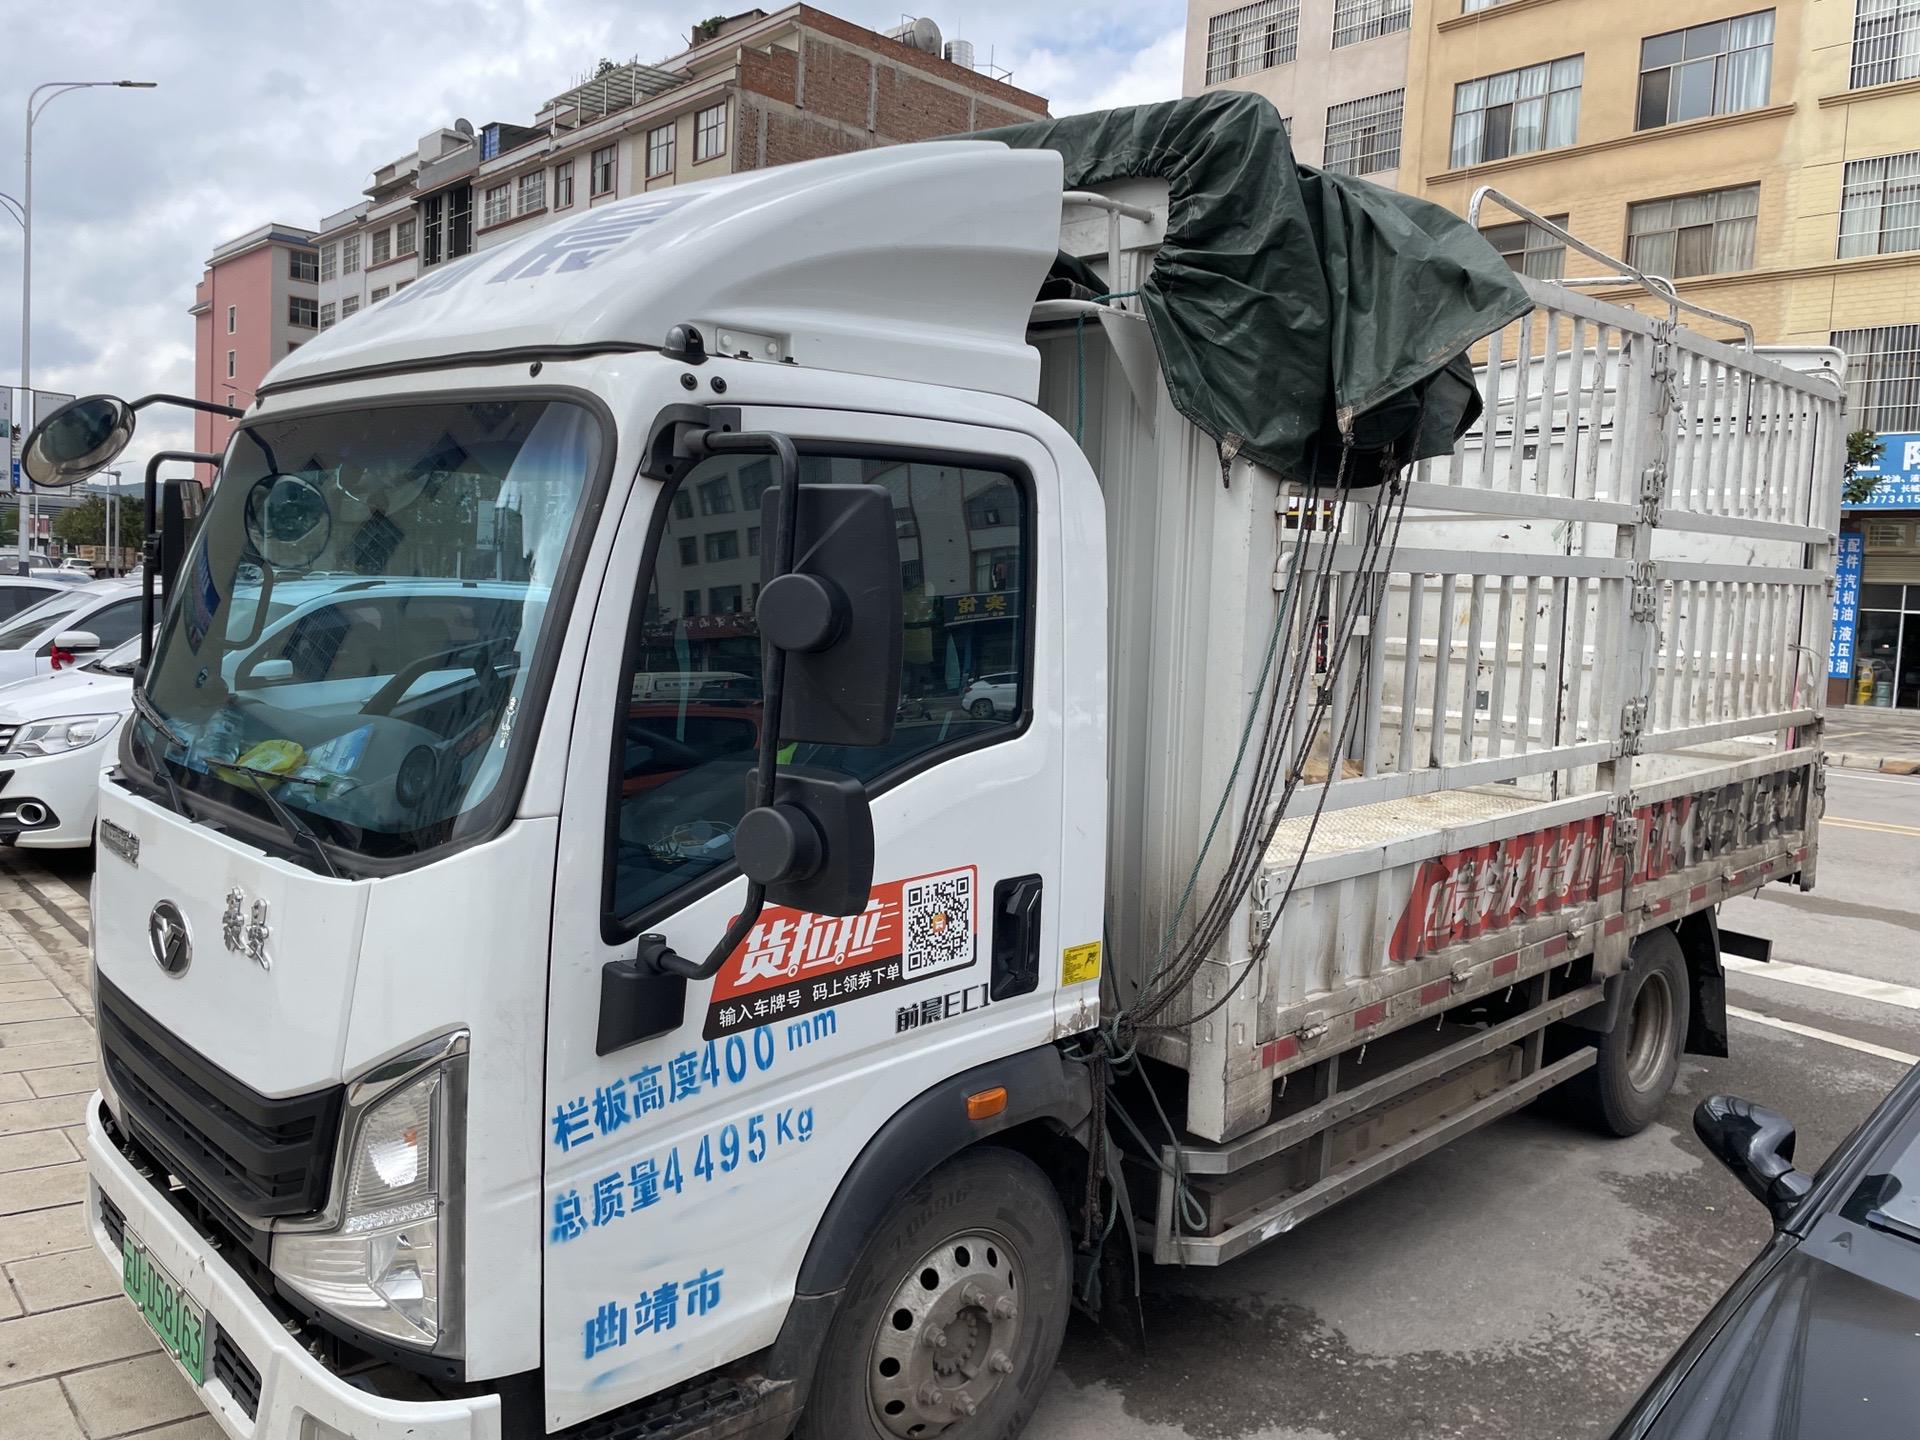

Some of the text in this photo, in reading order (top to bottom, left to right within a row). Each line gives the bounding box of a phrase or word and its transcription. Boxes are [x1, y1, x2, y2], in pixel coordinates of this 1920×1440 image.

[1835, 538, 1861, 674] 配件 汽机油 液压油
[719, 962, 900, 1028] 输入车牌号 码上领券下单
[733, 899, 886, 987] 货拉拉
[552, 1009, 837, 1153] 栏板高度400 mm
[550, 1105, 814, 1242] 总质量4495 Kg
[584, 1267, 725, 1361] 曲靖市
